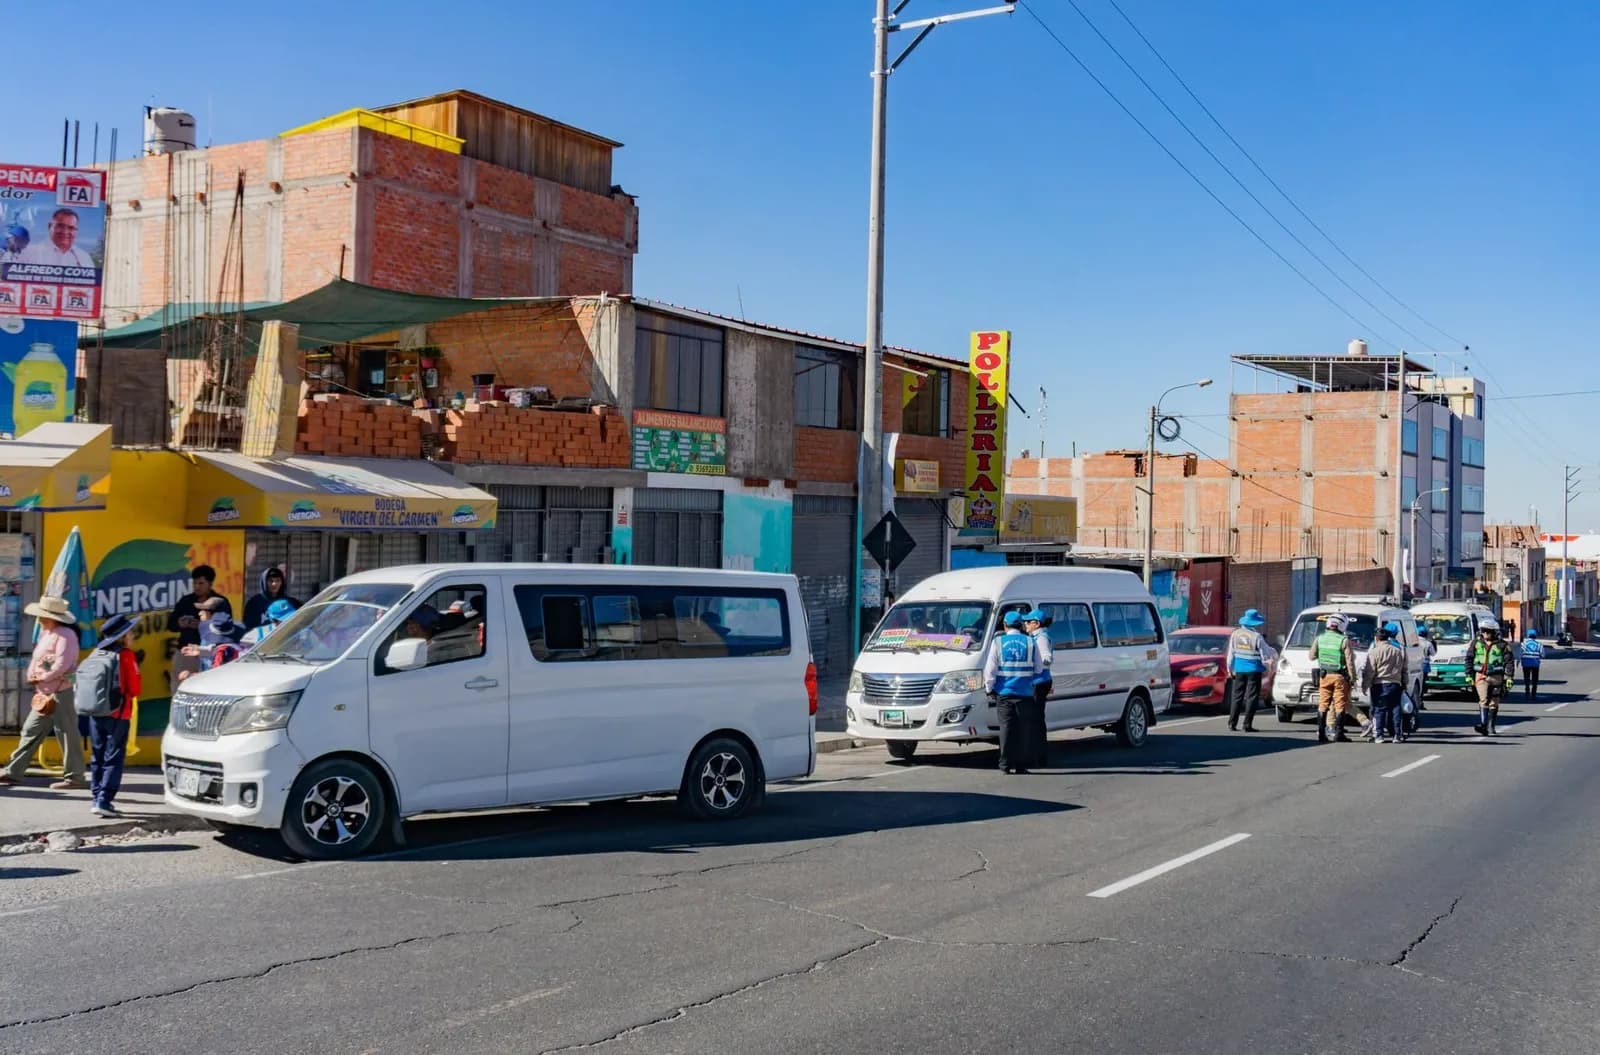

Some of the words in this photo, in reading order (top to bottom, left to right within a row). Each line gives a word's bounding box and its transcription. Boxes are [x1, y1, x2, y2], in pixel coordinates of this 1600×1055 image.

[68, 186, 89, 202] FA
[9, 264, 64, 275] ALFREDO
[64, 268, 96, 278] COYA
[33, 295, 49, 305] FA
[70, 296, 86, 307] FA
[969, 332, 1001, 492] POLLERIA
[637, 412, 677, 428] ALIMENTOS
[374, 498, 406, 511] BODEGA
[287, 511, 321, 522] ENERGINA
[379, 511, 398, 526] DEL
[90, 578, 194, 617] NERGIN
